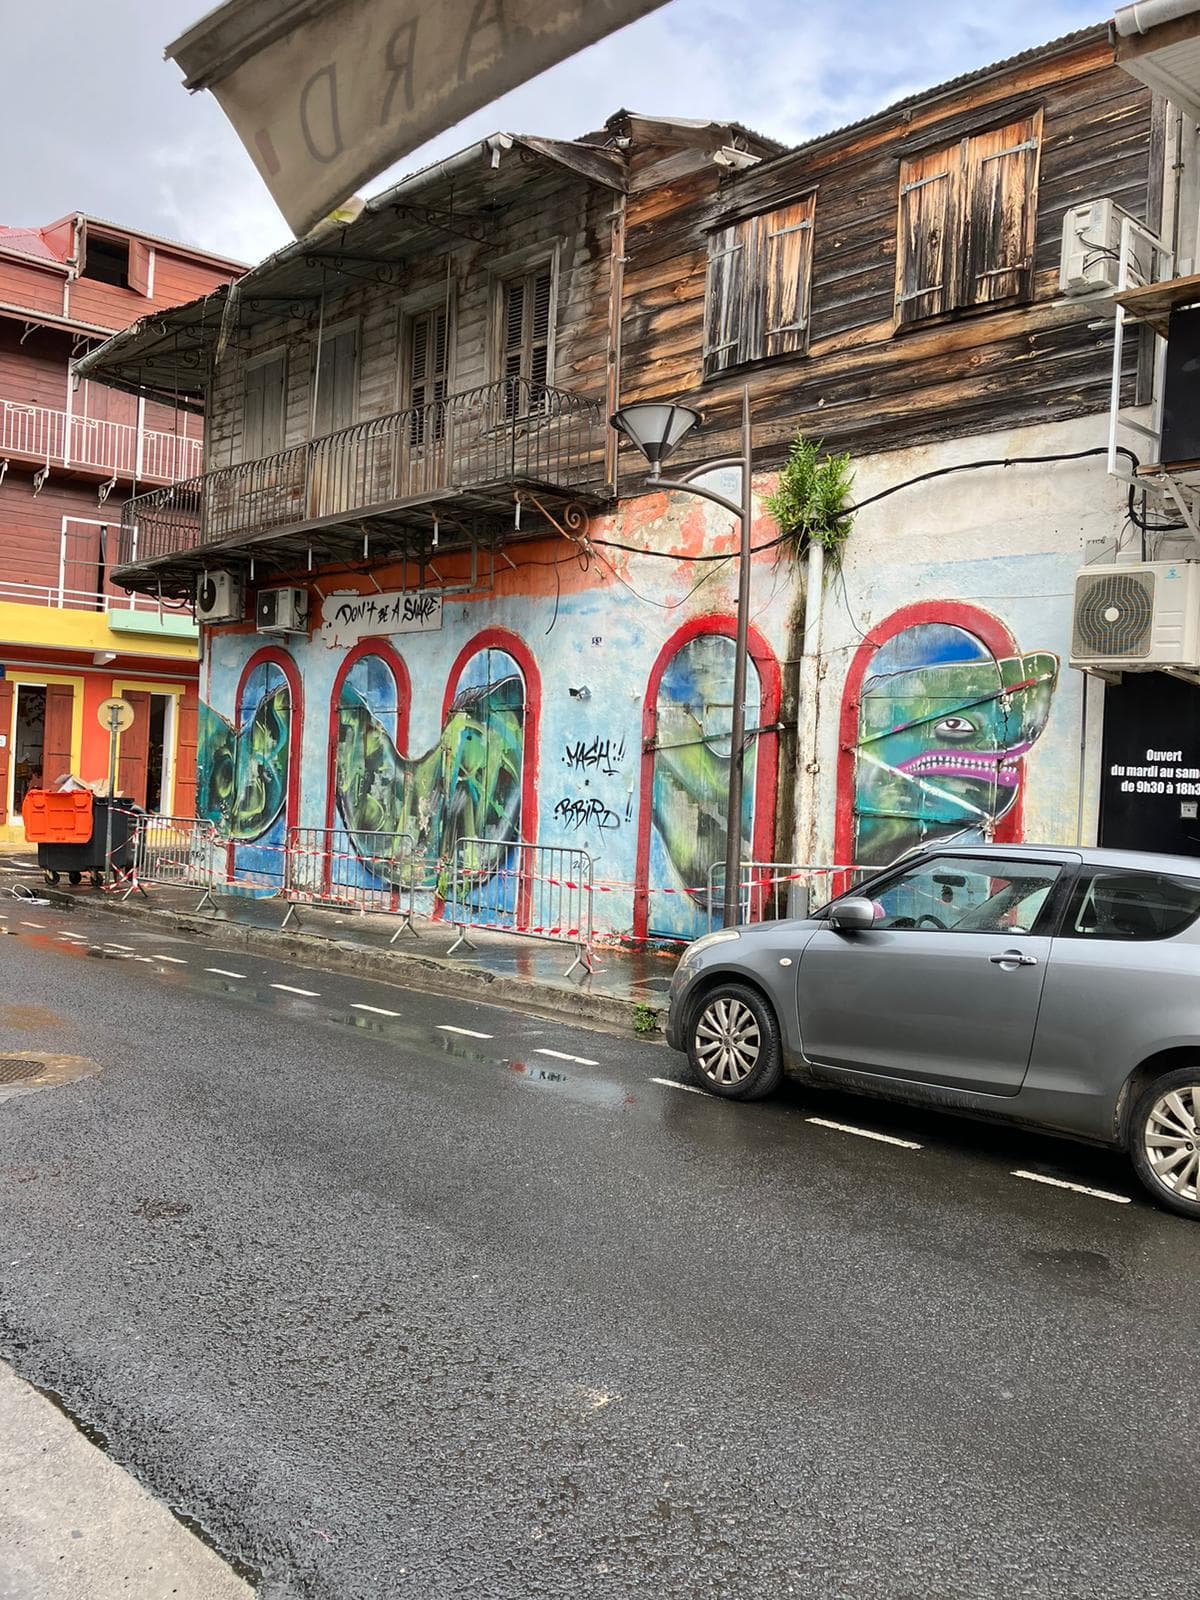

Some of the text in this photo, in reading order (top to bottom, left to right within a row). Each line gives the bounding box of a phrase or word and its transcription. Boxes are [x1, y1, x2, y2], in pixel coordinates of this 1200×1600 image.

[391, 597, 400, 622] A
[1146, 749, 1183, 762] Ouvert
[1111, 764, 1200, 779] du mardi au sam
[1121, 781, 1135, 792] de
[1136, 781, 1165, 794] 9h30
[1166, 782, 1174, 794] à
